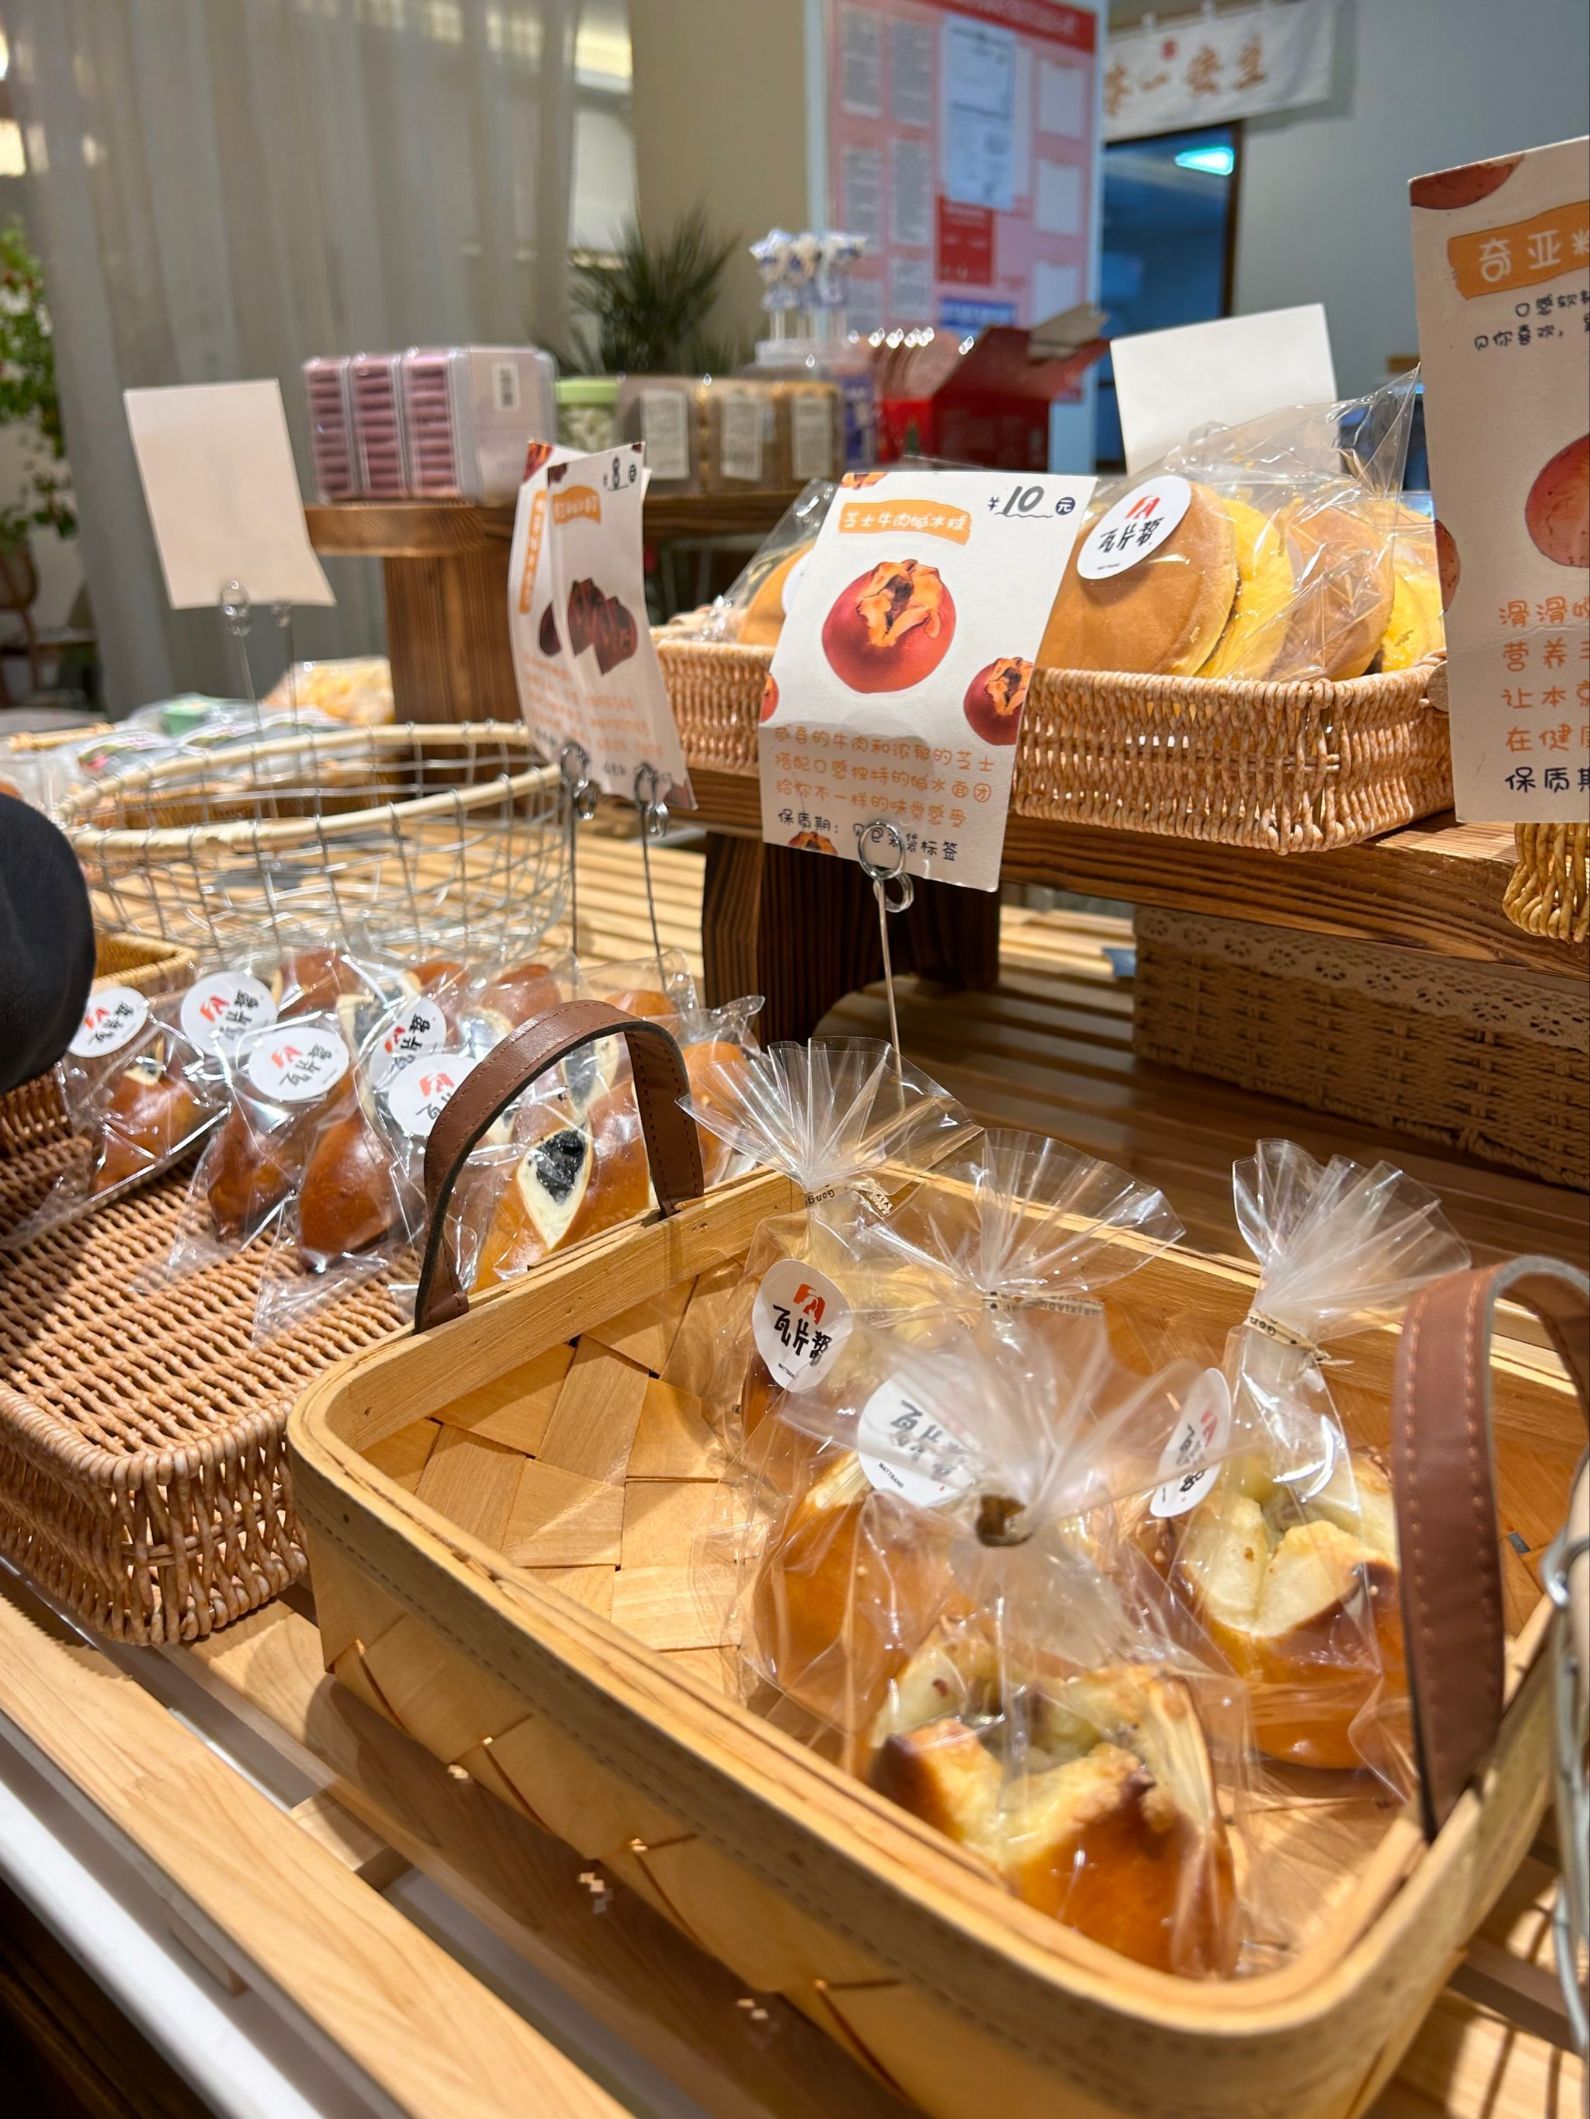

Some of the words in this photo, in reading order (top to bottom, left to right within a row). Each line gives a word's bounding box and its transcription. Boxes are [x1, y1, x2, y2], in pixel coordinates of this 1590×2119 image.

[1097, 516, 1164, 553] 瓦片帮
[773, 1304, 832, 1367] 瓦片帮
